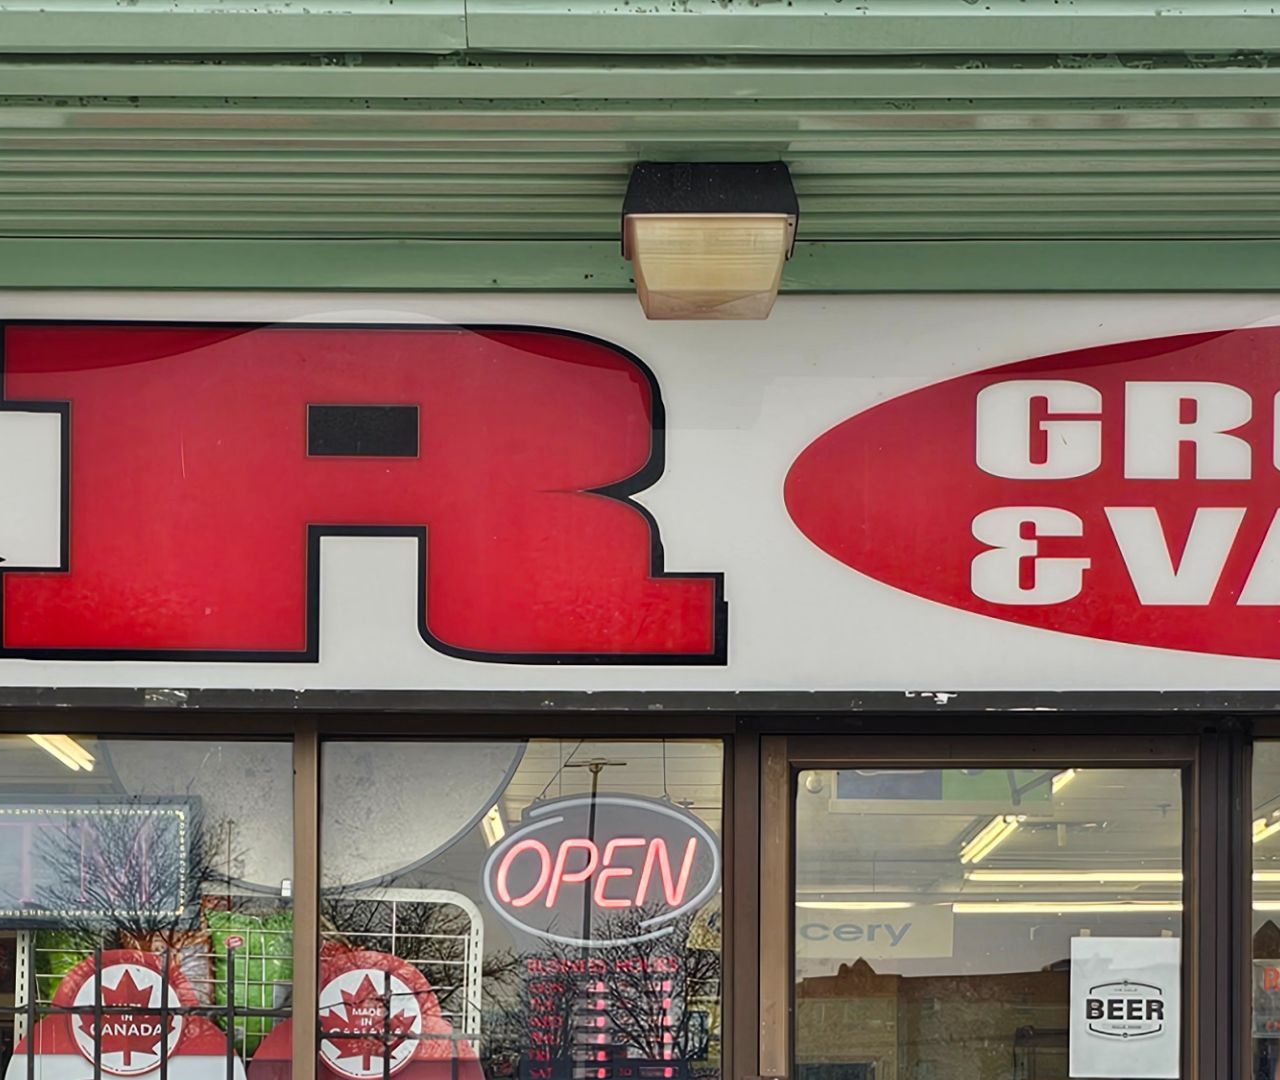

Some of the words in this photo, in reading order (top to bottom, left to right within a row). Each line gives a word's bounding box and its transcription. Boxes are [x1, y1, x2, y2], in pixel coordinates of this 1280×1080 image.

[497, 837, 696, 908] OPEN
[352, 1008, 383, 1016] MADE
[1086, 998, 1164, 1021] BEER
[361, 1018, 373, 1026] IN
